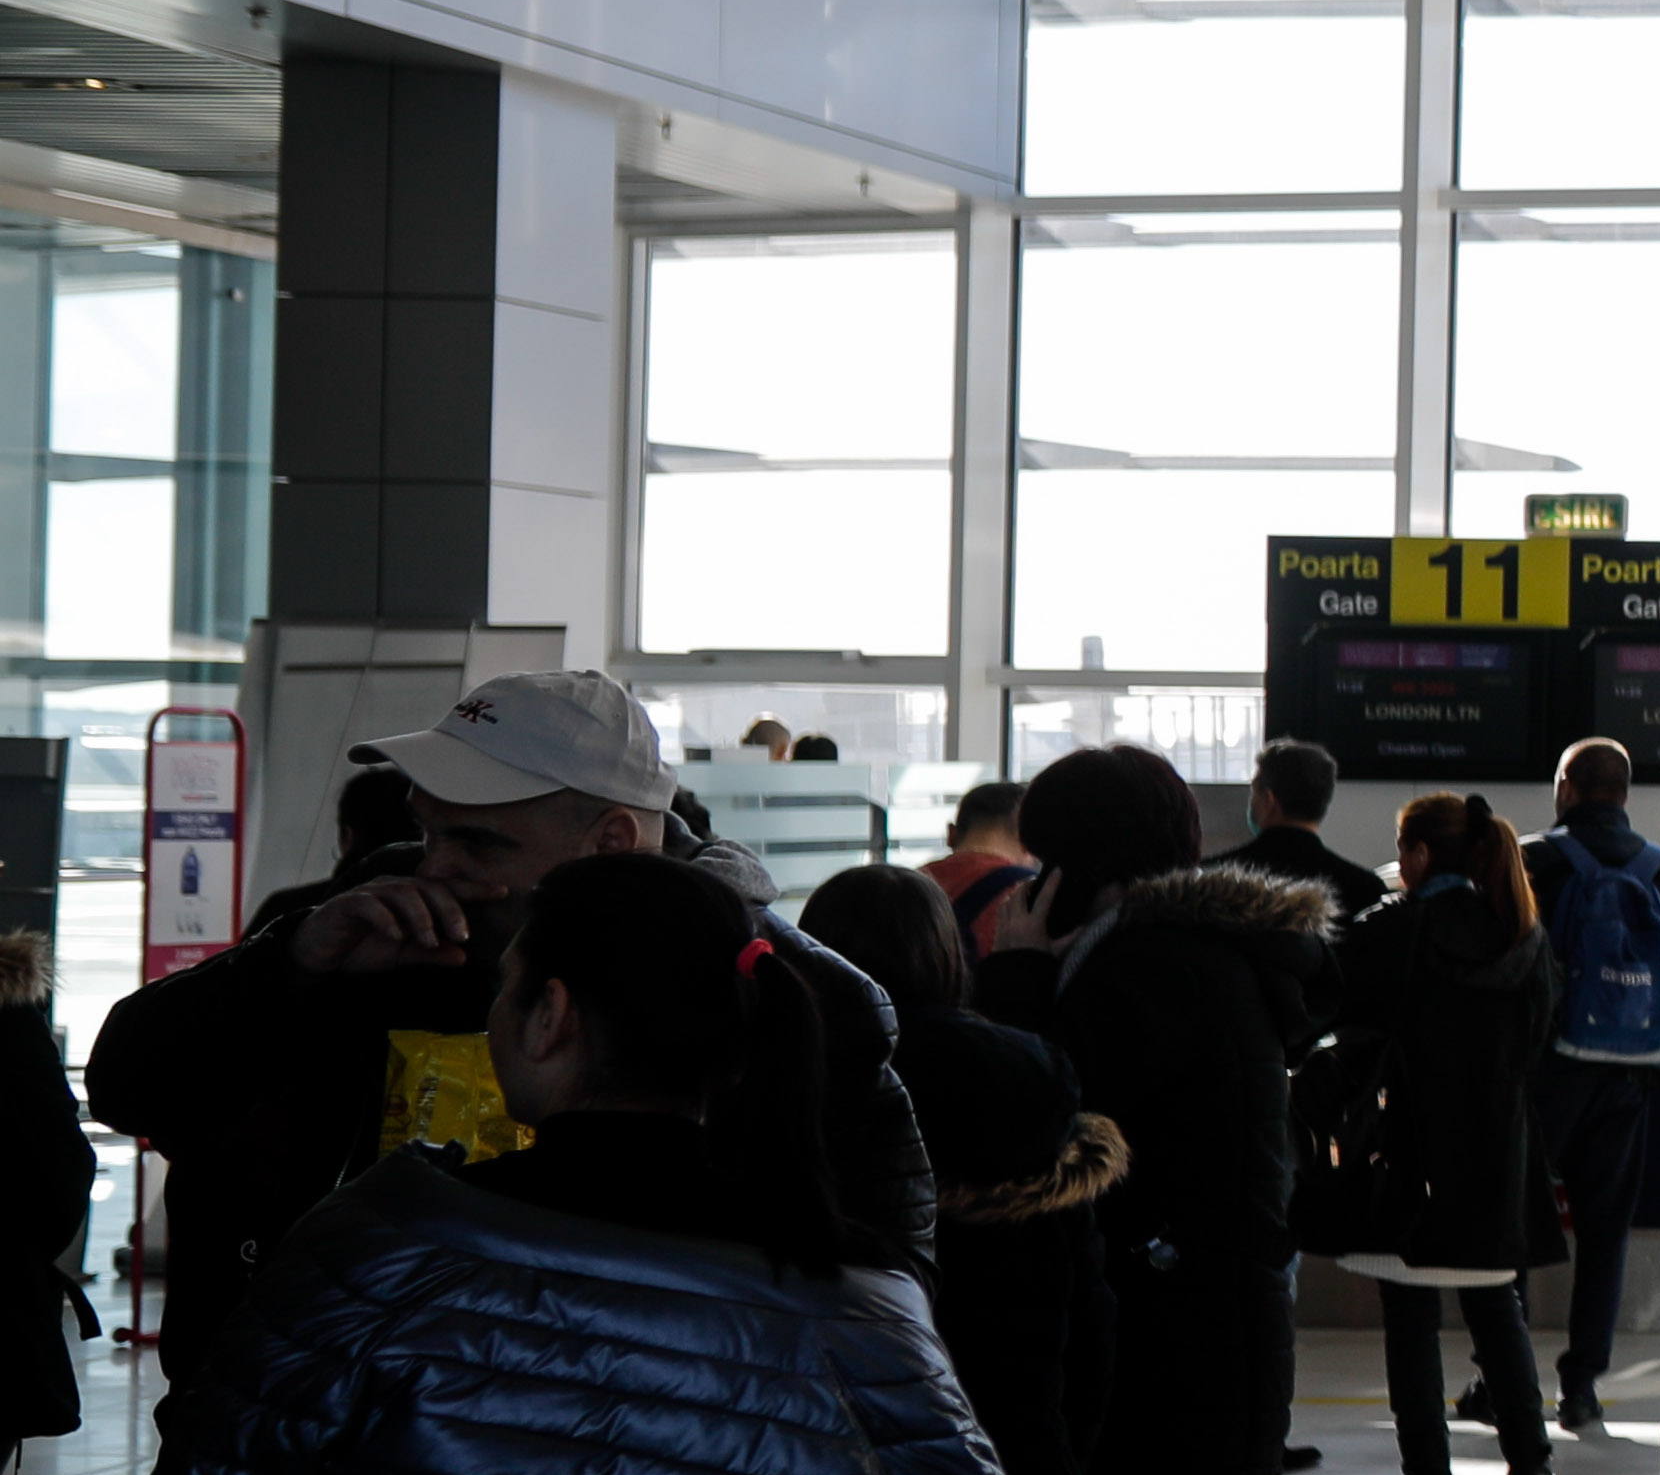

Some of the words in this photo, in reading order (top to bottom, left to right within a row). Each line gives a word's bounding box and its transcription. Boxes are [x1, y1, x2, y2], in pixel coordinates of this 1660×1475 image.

[1279, 549, 1379, 580] Poarta
[1428, 543, 1520, 621] 11
[1319, 590, 1379, 617] Gate
[1364, 702, 1442, 722] LONDON
[1446, 703, 1481, 722] LTN
